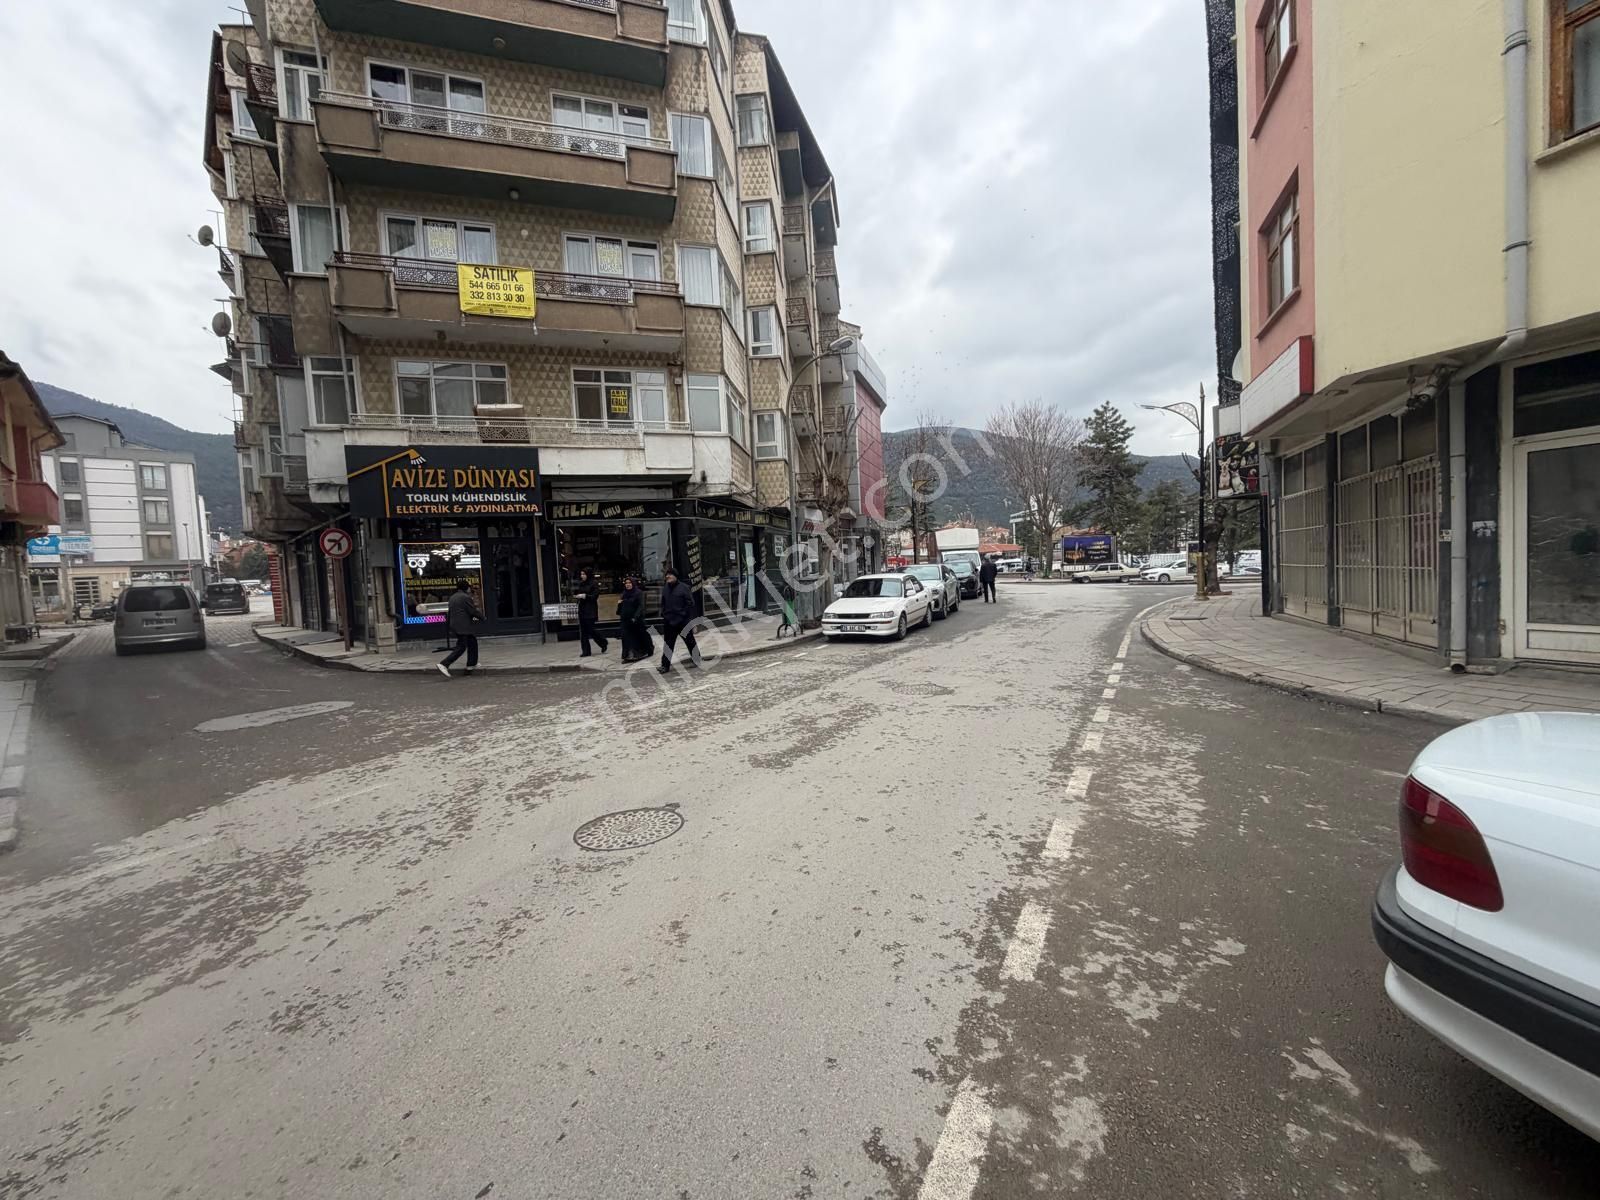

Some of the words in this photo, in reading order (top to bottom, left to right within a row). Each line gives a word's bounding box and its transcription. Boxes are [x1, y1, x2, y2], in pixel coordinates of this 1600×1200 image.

[473, 266, 519, 282] SATILIK
[469, 280, 484, 289] 544
[486, 281, 501, 291] 665
[502, 282, 512, 291] 01
[514, 283, 524, 292] 66
[469, 290, 484, 300] 332
[486, 292, 501, 301] 813
[503, 293, 513, 302] 30
[515, 294, 525, 303] 30
[392, 465, 448, 488] AVİZE
[454, 465, 536, 488] DÜNYASI
[406, 493, 449, 502] TORUN
[452, 491, 527, 502] MÜHENDİSLİK
[396, 503, 450, 514] ELEKTRİK
[453, 504, 463, 513] &
[466, 503, 539, 513] AYDINLATMA
[553, 503, 599, 518] KİLİM
